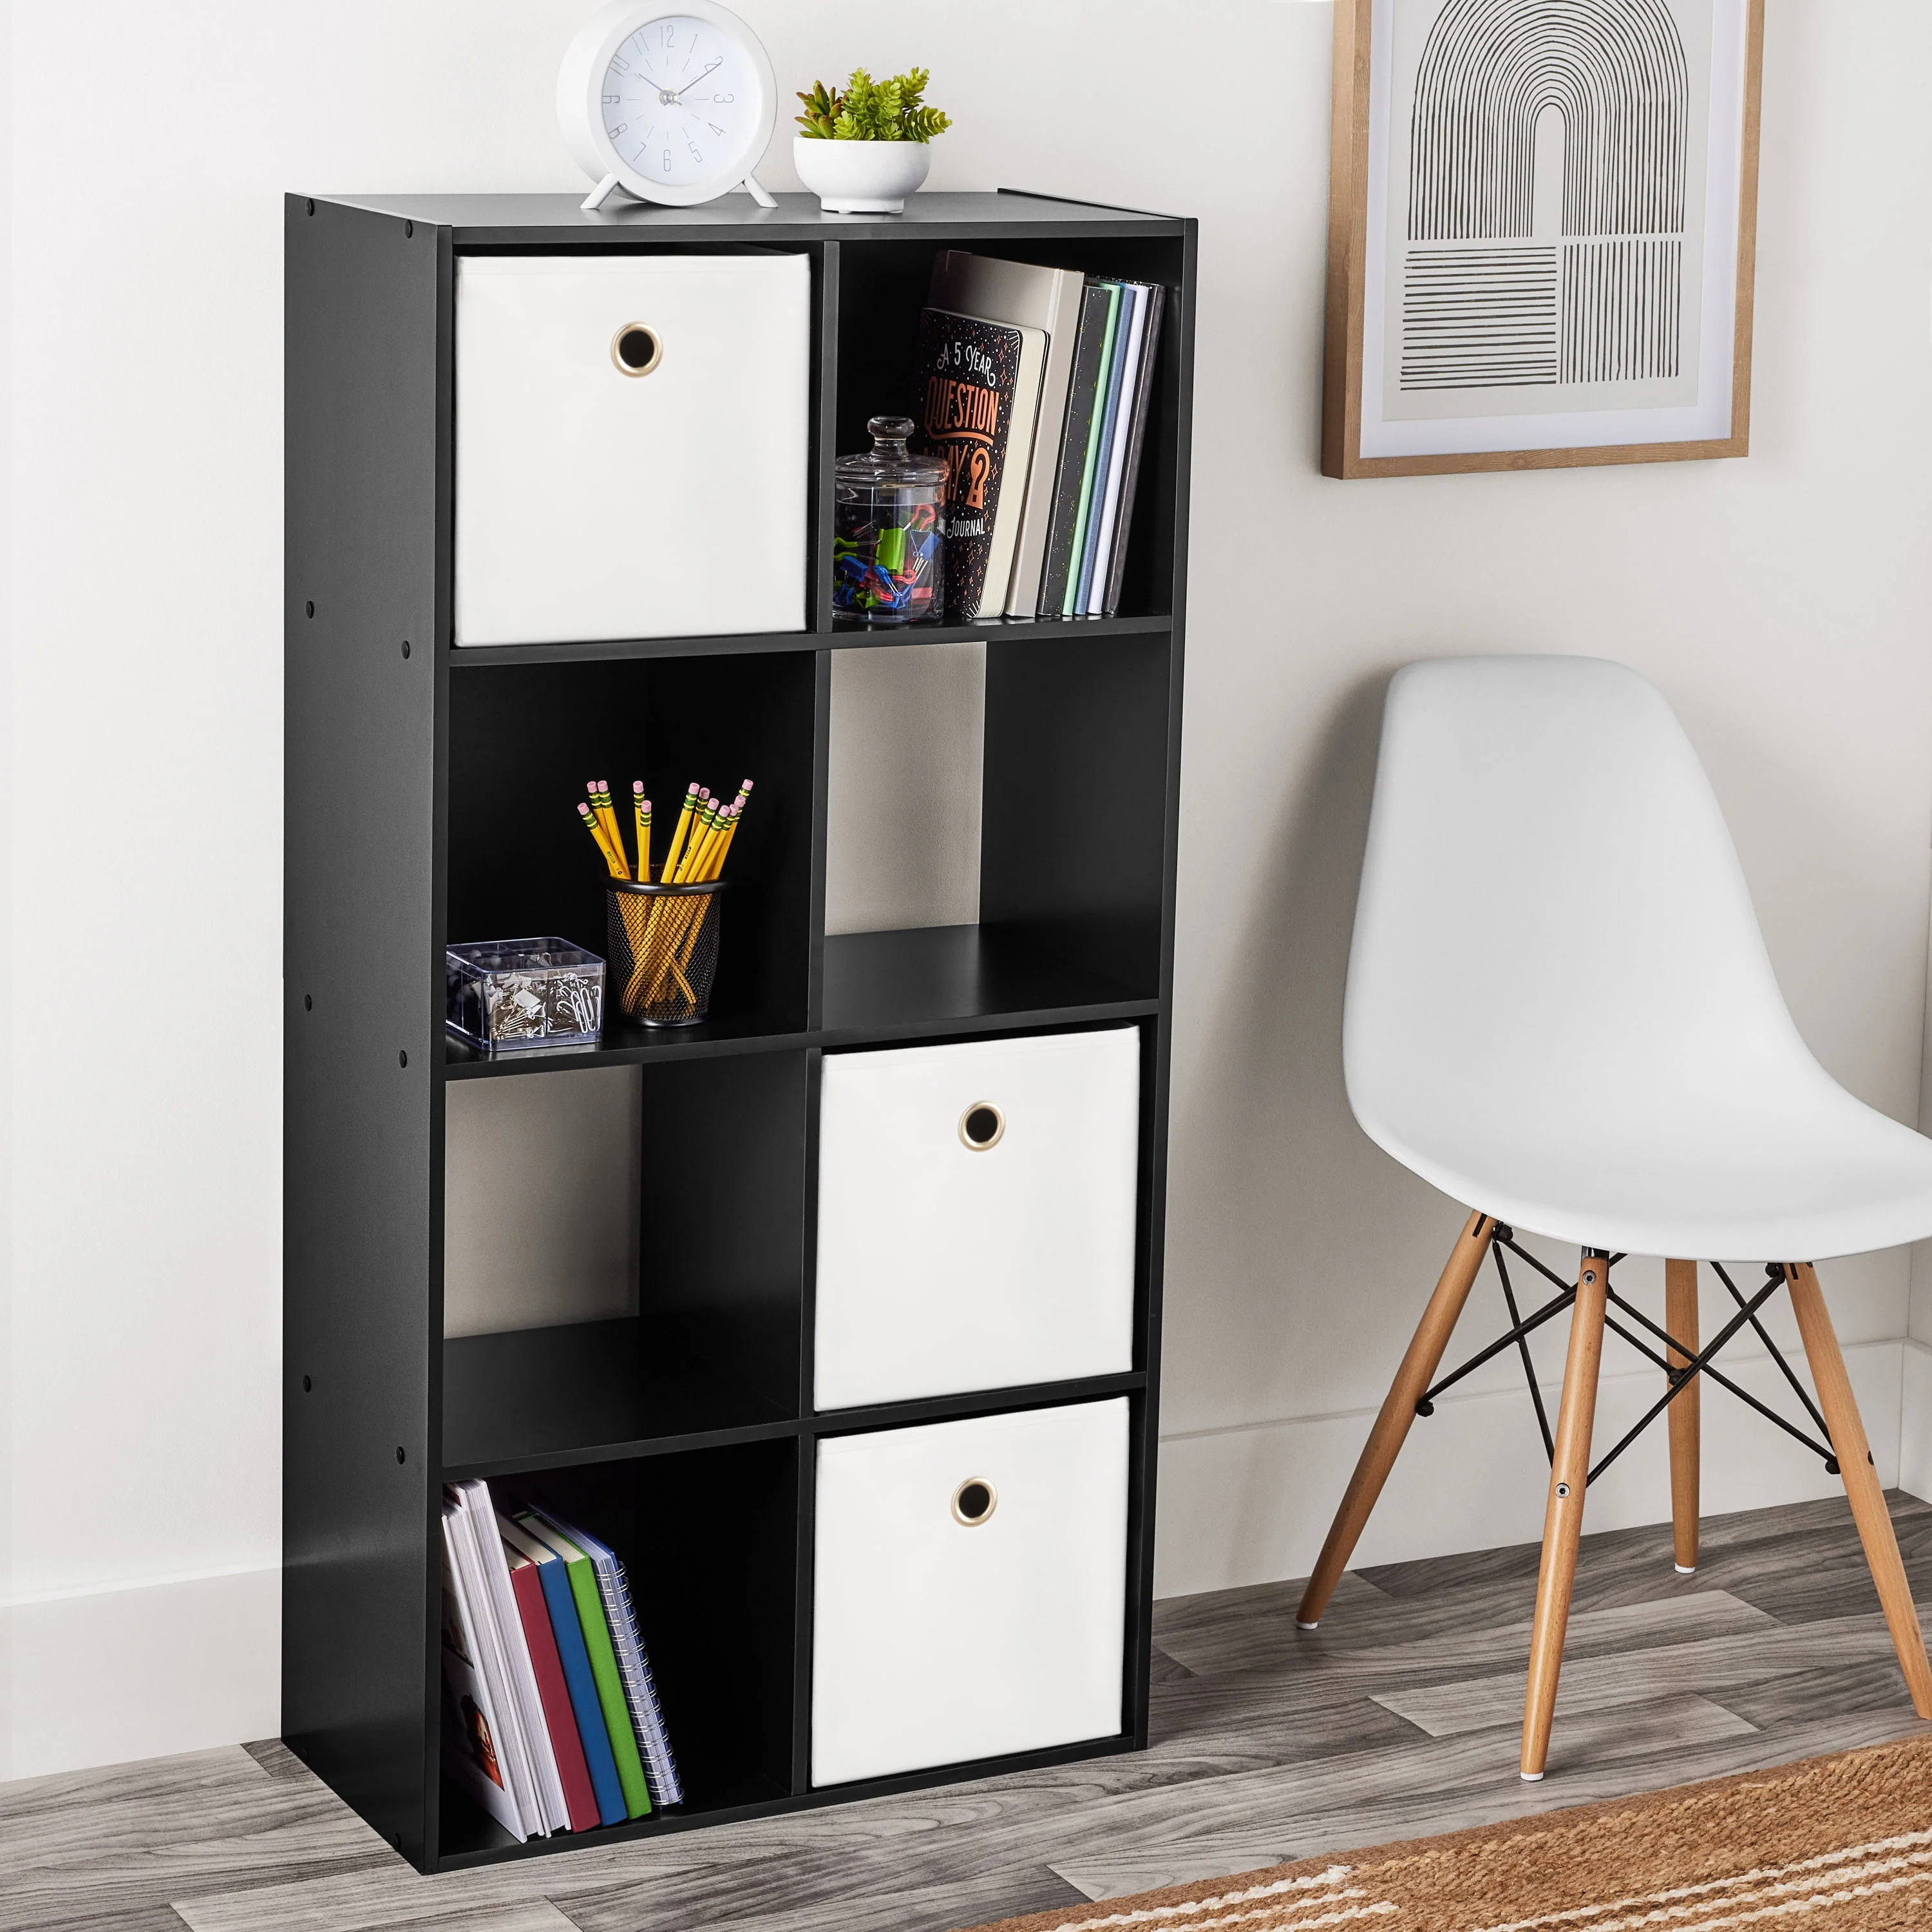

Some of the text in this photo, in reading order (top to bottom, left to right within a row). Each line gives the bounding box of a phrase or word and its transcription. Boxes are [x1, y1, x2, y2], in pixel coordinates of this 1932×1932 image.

[632, 32, 649, 55] 11
[659, 25, 674, 48] 12
[609, 54, 630, 77] 10
[714, 93, 734, 103] 3
[608, 123, 628, 139] 8
[708, 122, 726, 136] 4
[632, 142, 647, 162] 7
[663, 149, 671, 172] 6
[688, 141, 703, 163] 5
[937, 342, 996, 387] A 5 YEAR
[925, 376, 999, 444] QUESTION
[946, 516, 985, 539] JOURNAL
